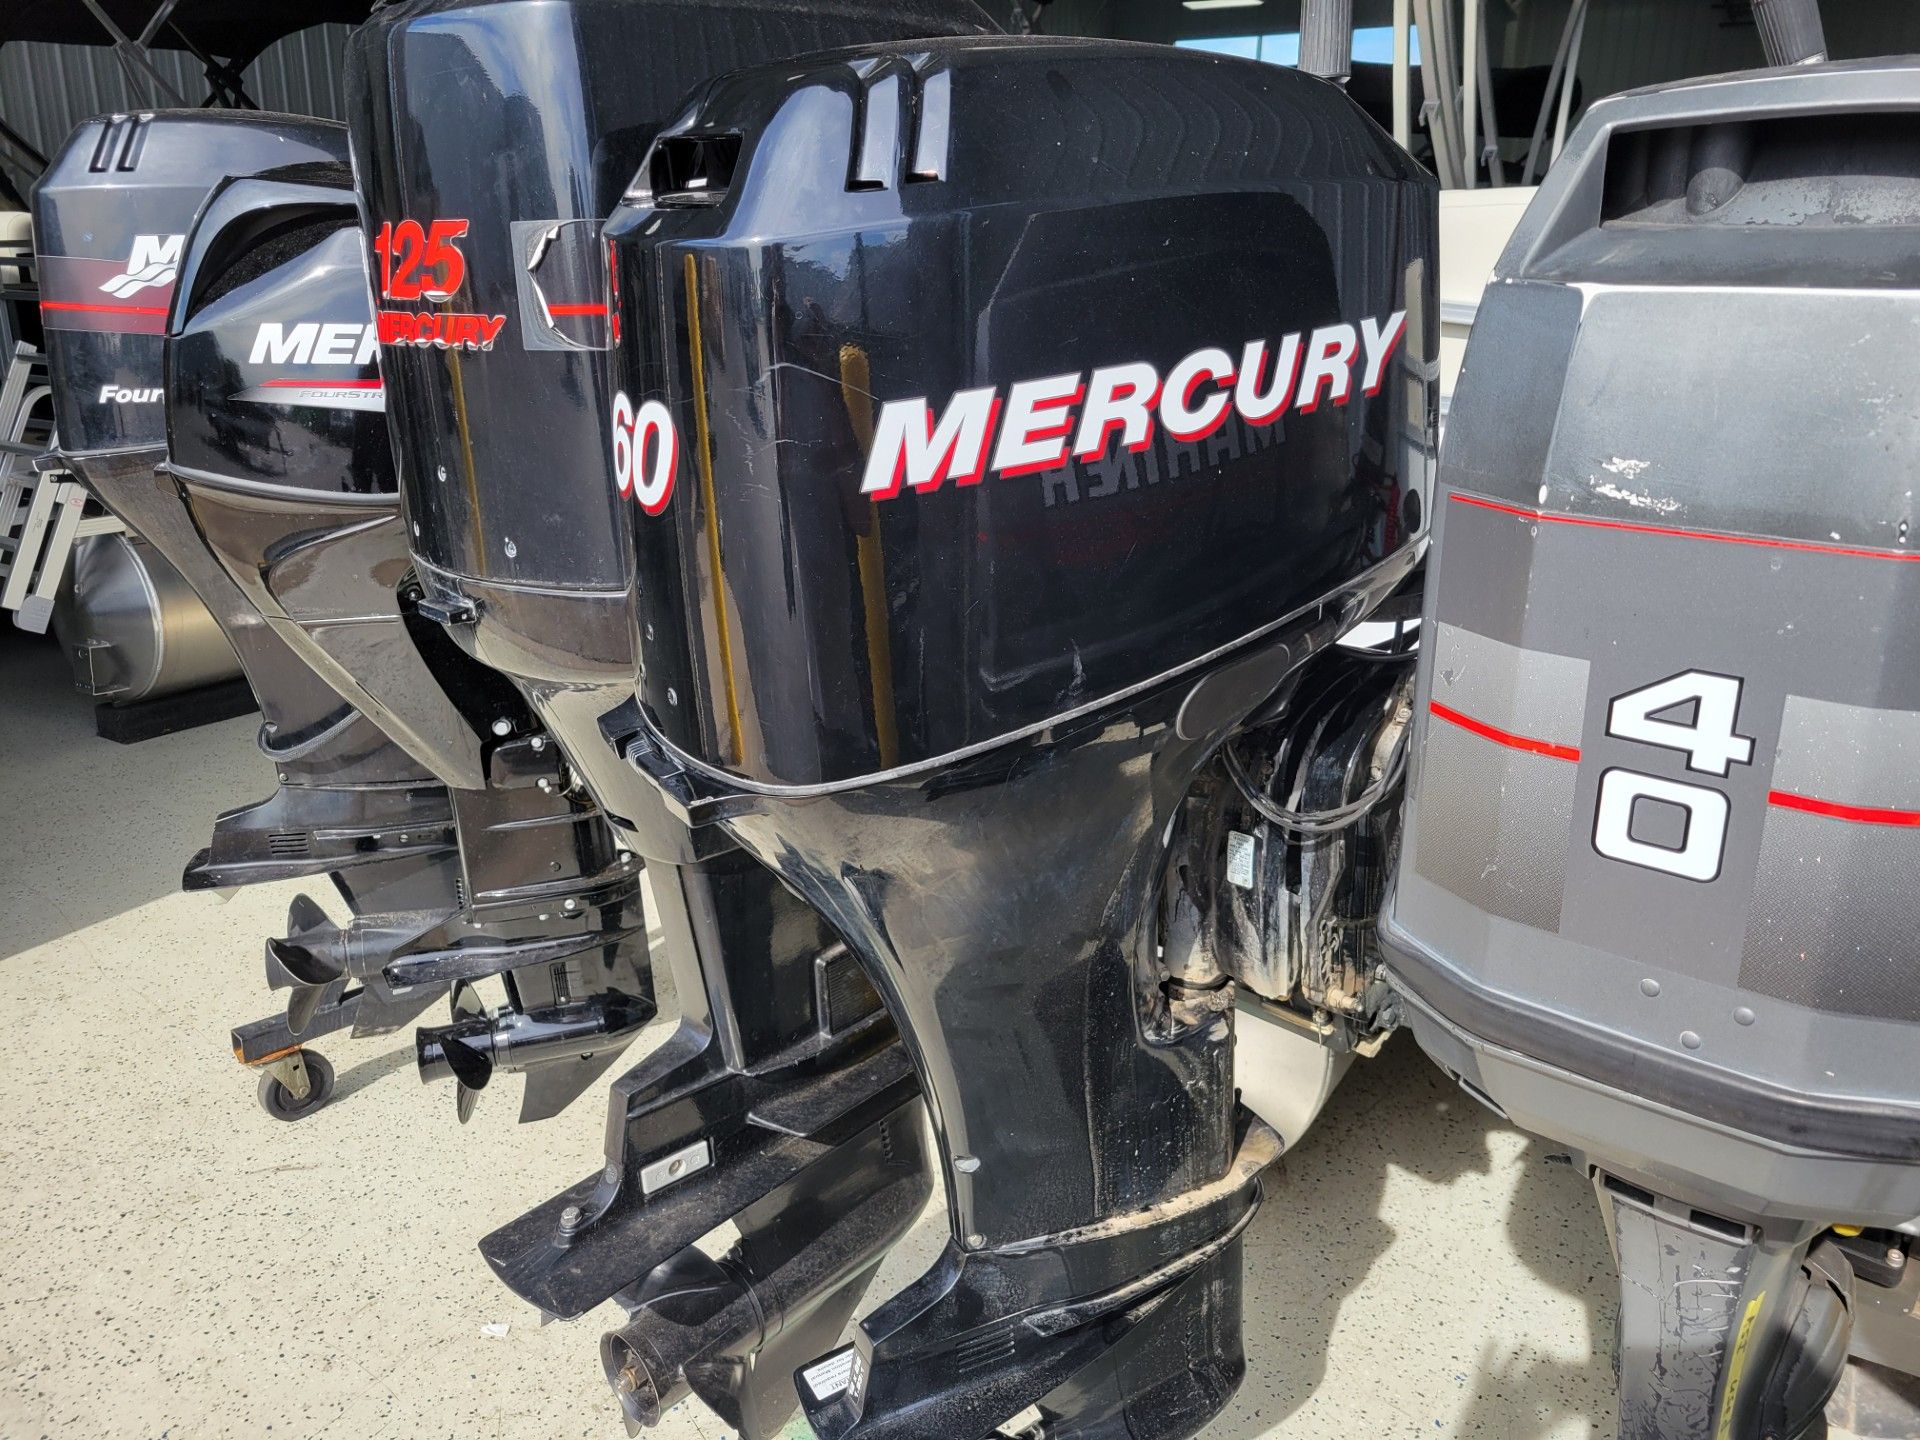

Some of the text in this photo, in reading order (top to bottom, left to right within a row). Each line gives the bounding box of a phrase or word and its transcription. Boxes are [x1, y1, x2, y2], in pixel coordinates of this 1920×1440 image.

[374, 219, 469, 302] 125
[612, 389, 679, 516] 60
[861, 310, 1407, 501] MERCURY
[1591, 668, 1756, 884] 40
